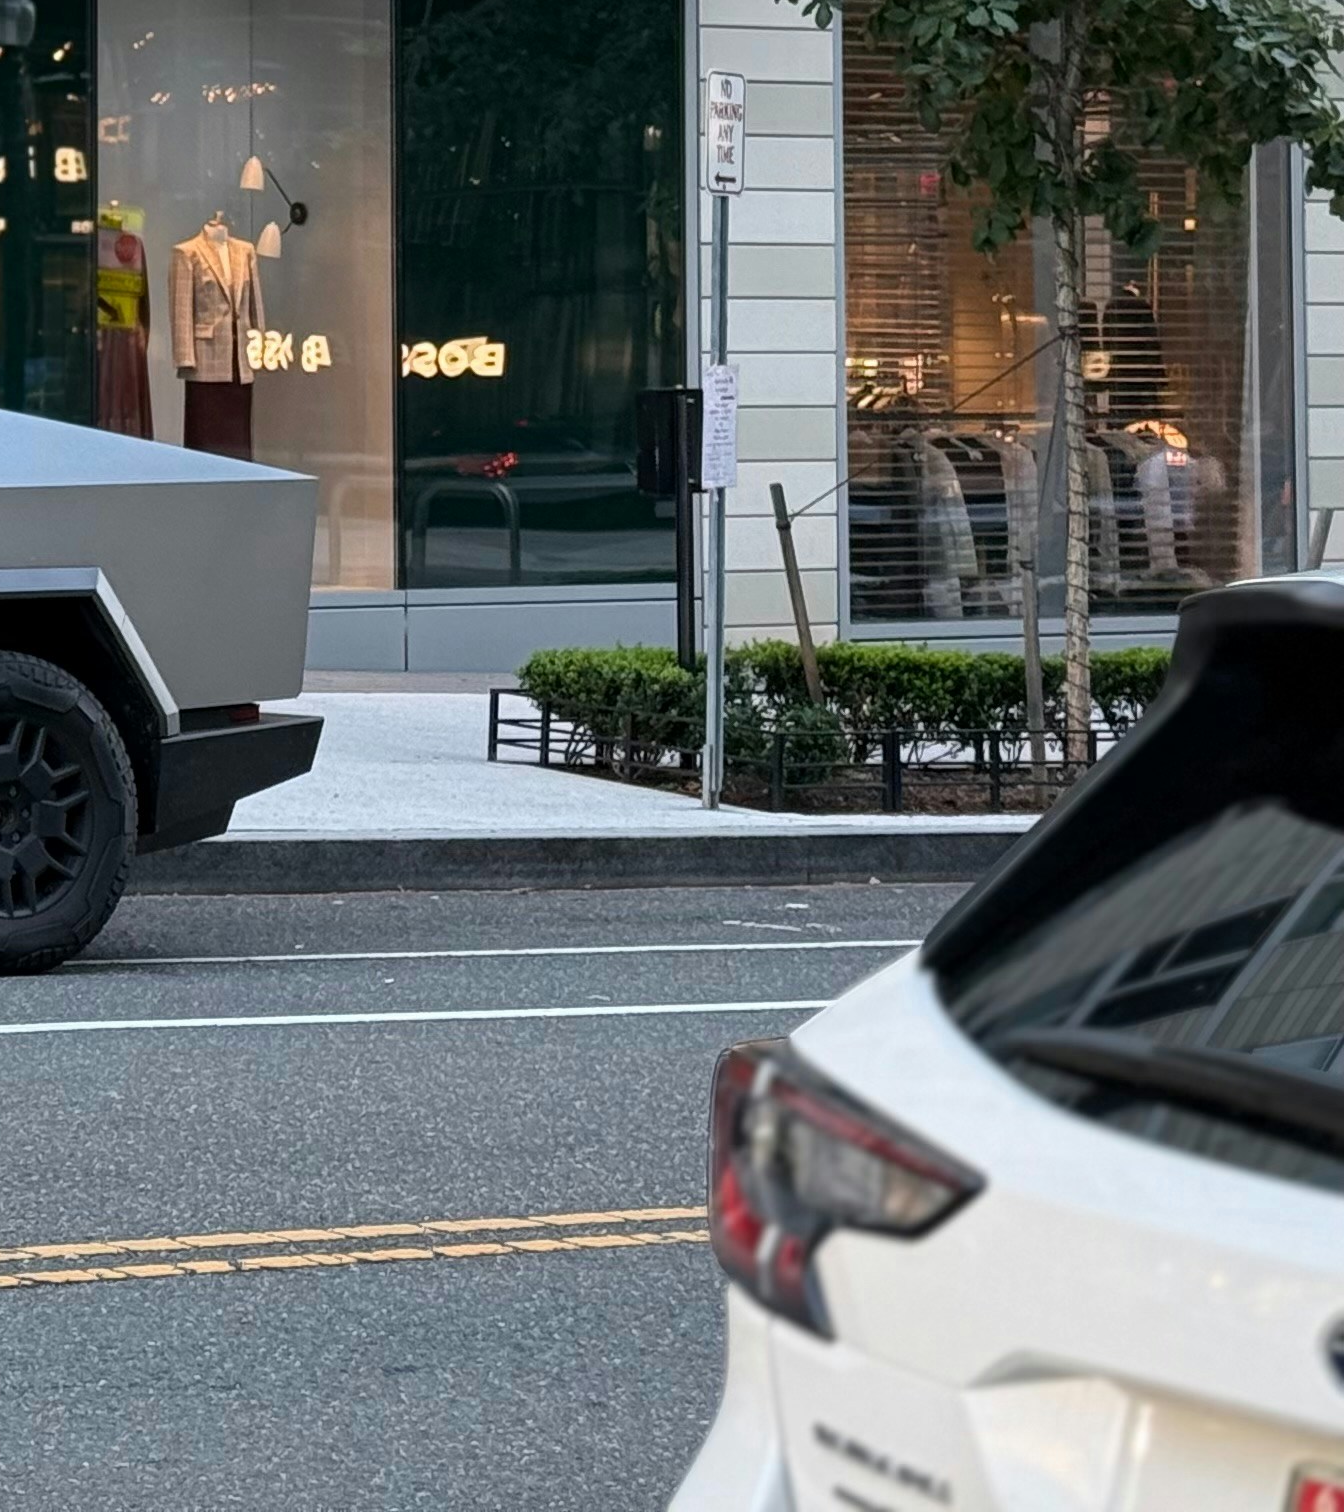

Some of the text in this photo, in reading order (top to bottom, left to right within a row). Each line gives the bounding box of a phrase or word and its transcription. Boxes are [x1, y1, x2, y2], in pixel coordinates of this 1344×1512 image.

[720, 78, 733, 100] NO
[710, 101, 743, 122] PARKING
[717, 124, 735, 144] ANY
[716, 144, 735, 165] TIME
